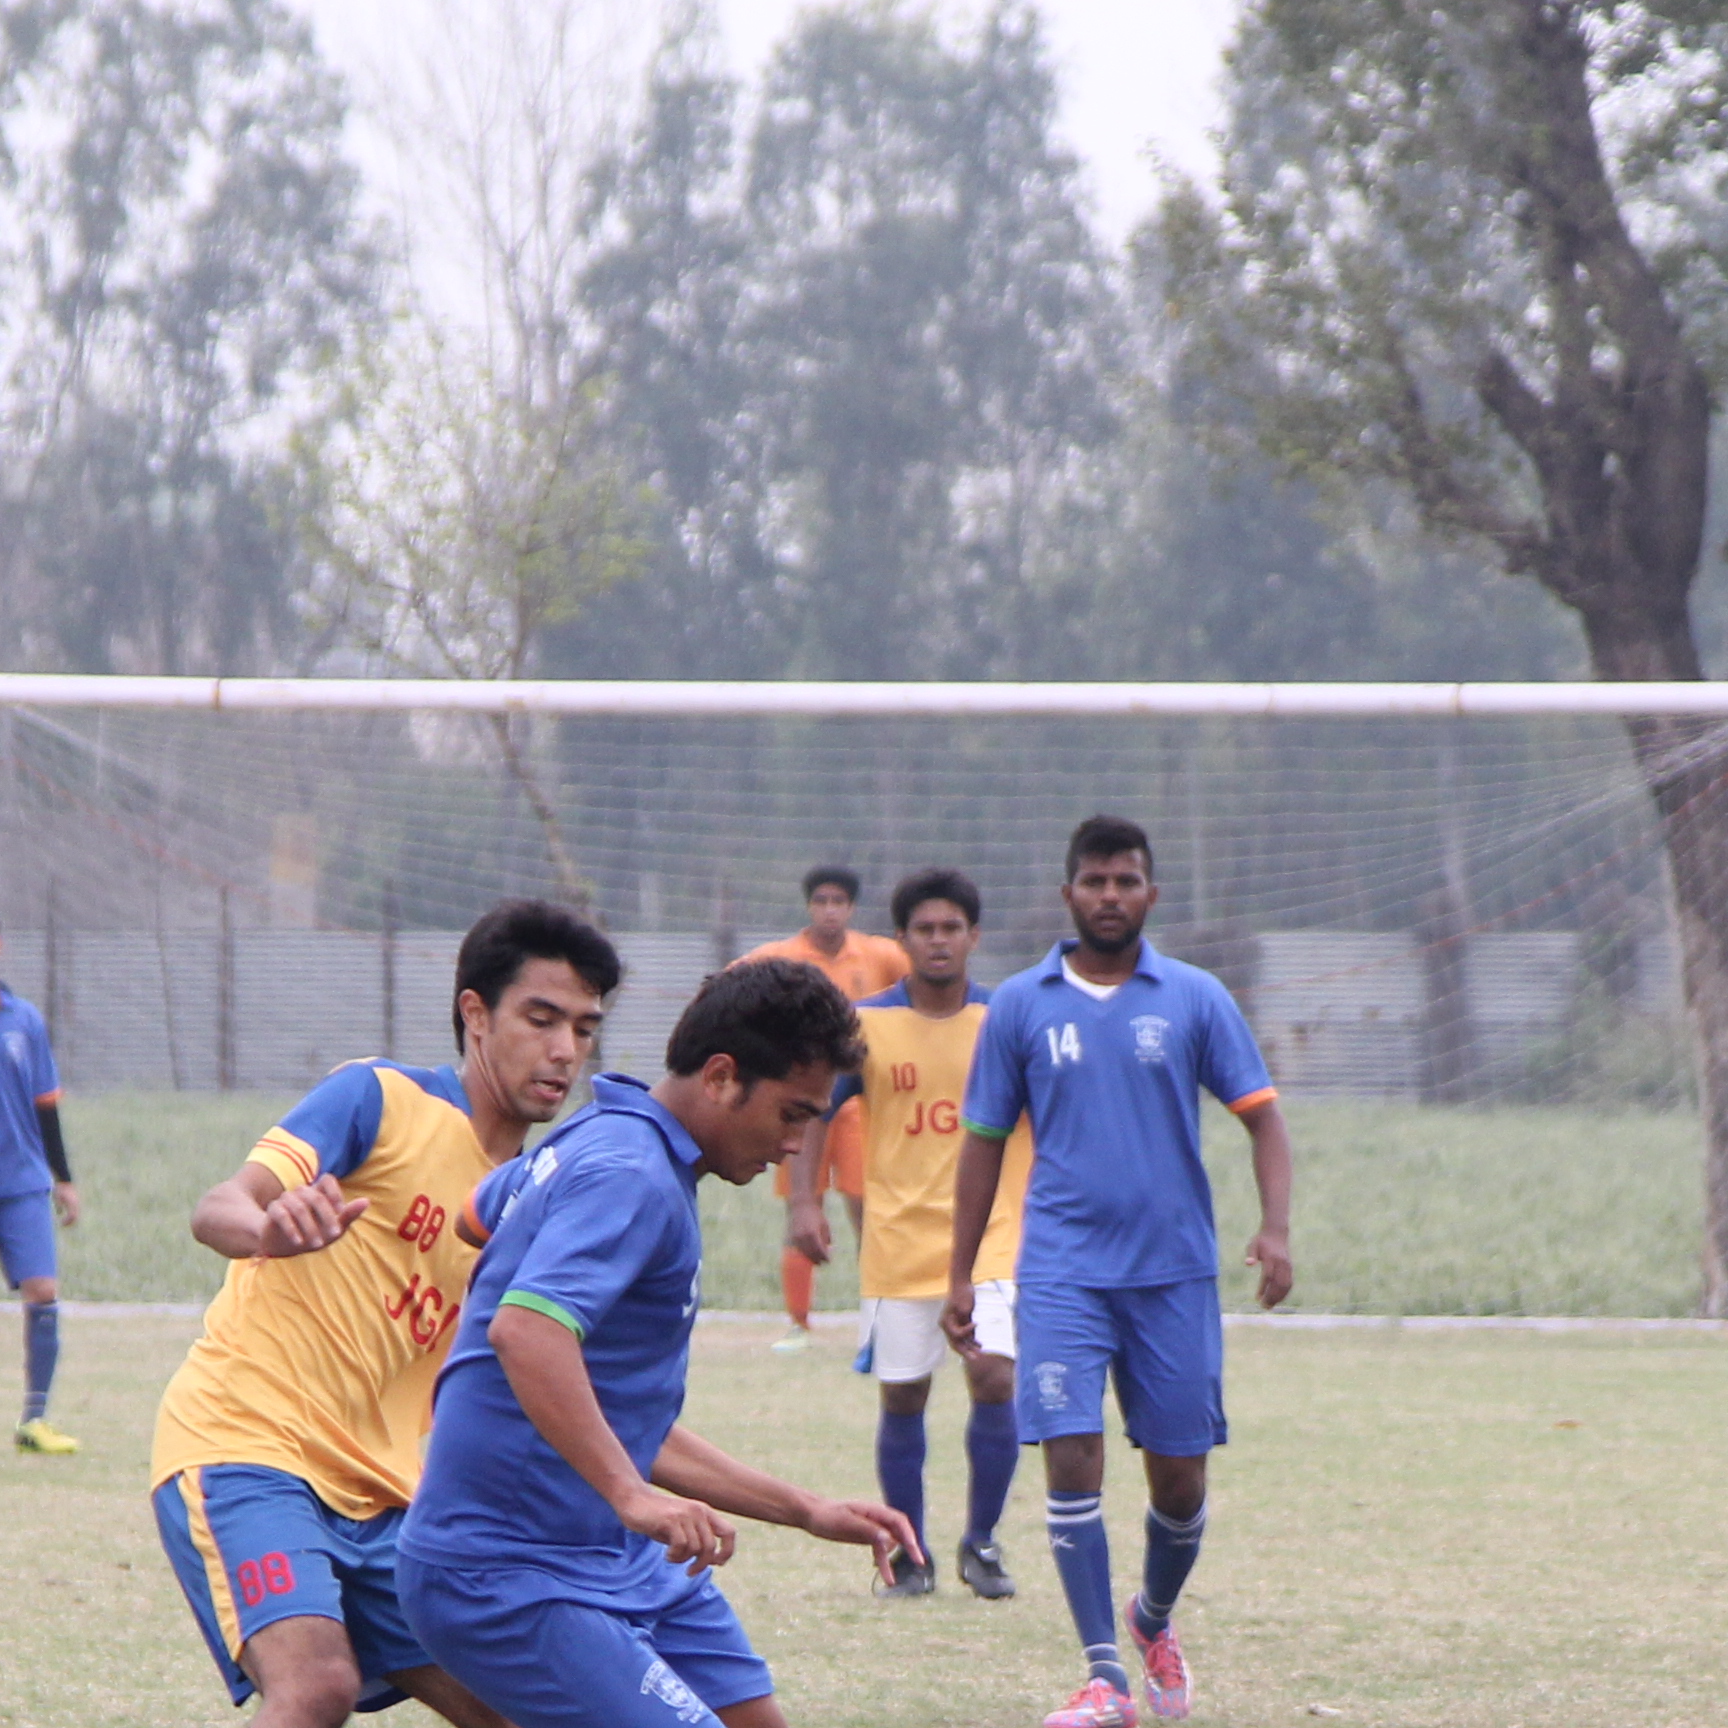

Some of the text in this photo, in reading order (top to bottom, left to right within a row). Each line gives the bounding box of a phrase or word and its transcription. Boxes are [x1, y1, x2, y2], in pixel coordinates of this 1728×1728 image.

[1046, 1022, 1081, 1066] 14
[890, 1061, 917, 1093] 10
[904, 1099, 959, 1136] JG
[397, 1193, 446, 1253] 88
[236, 1550, 298, 1608] 88
